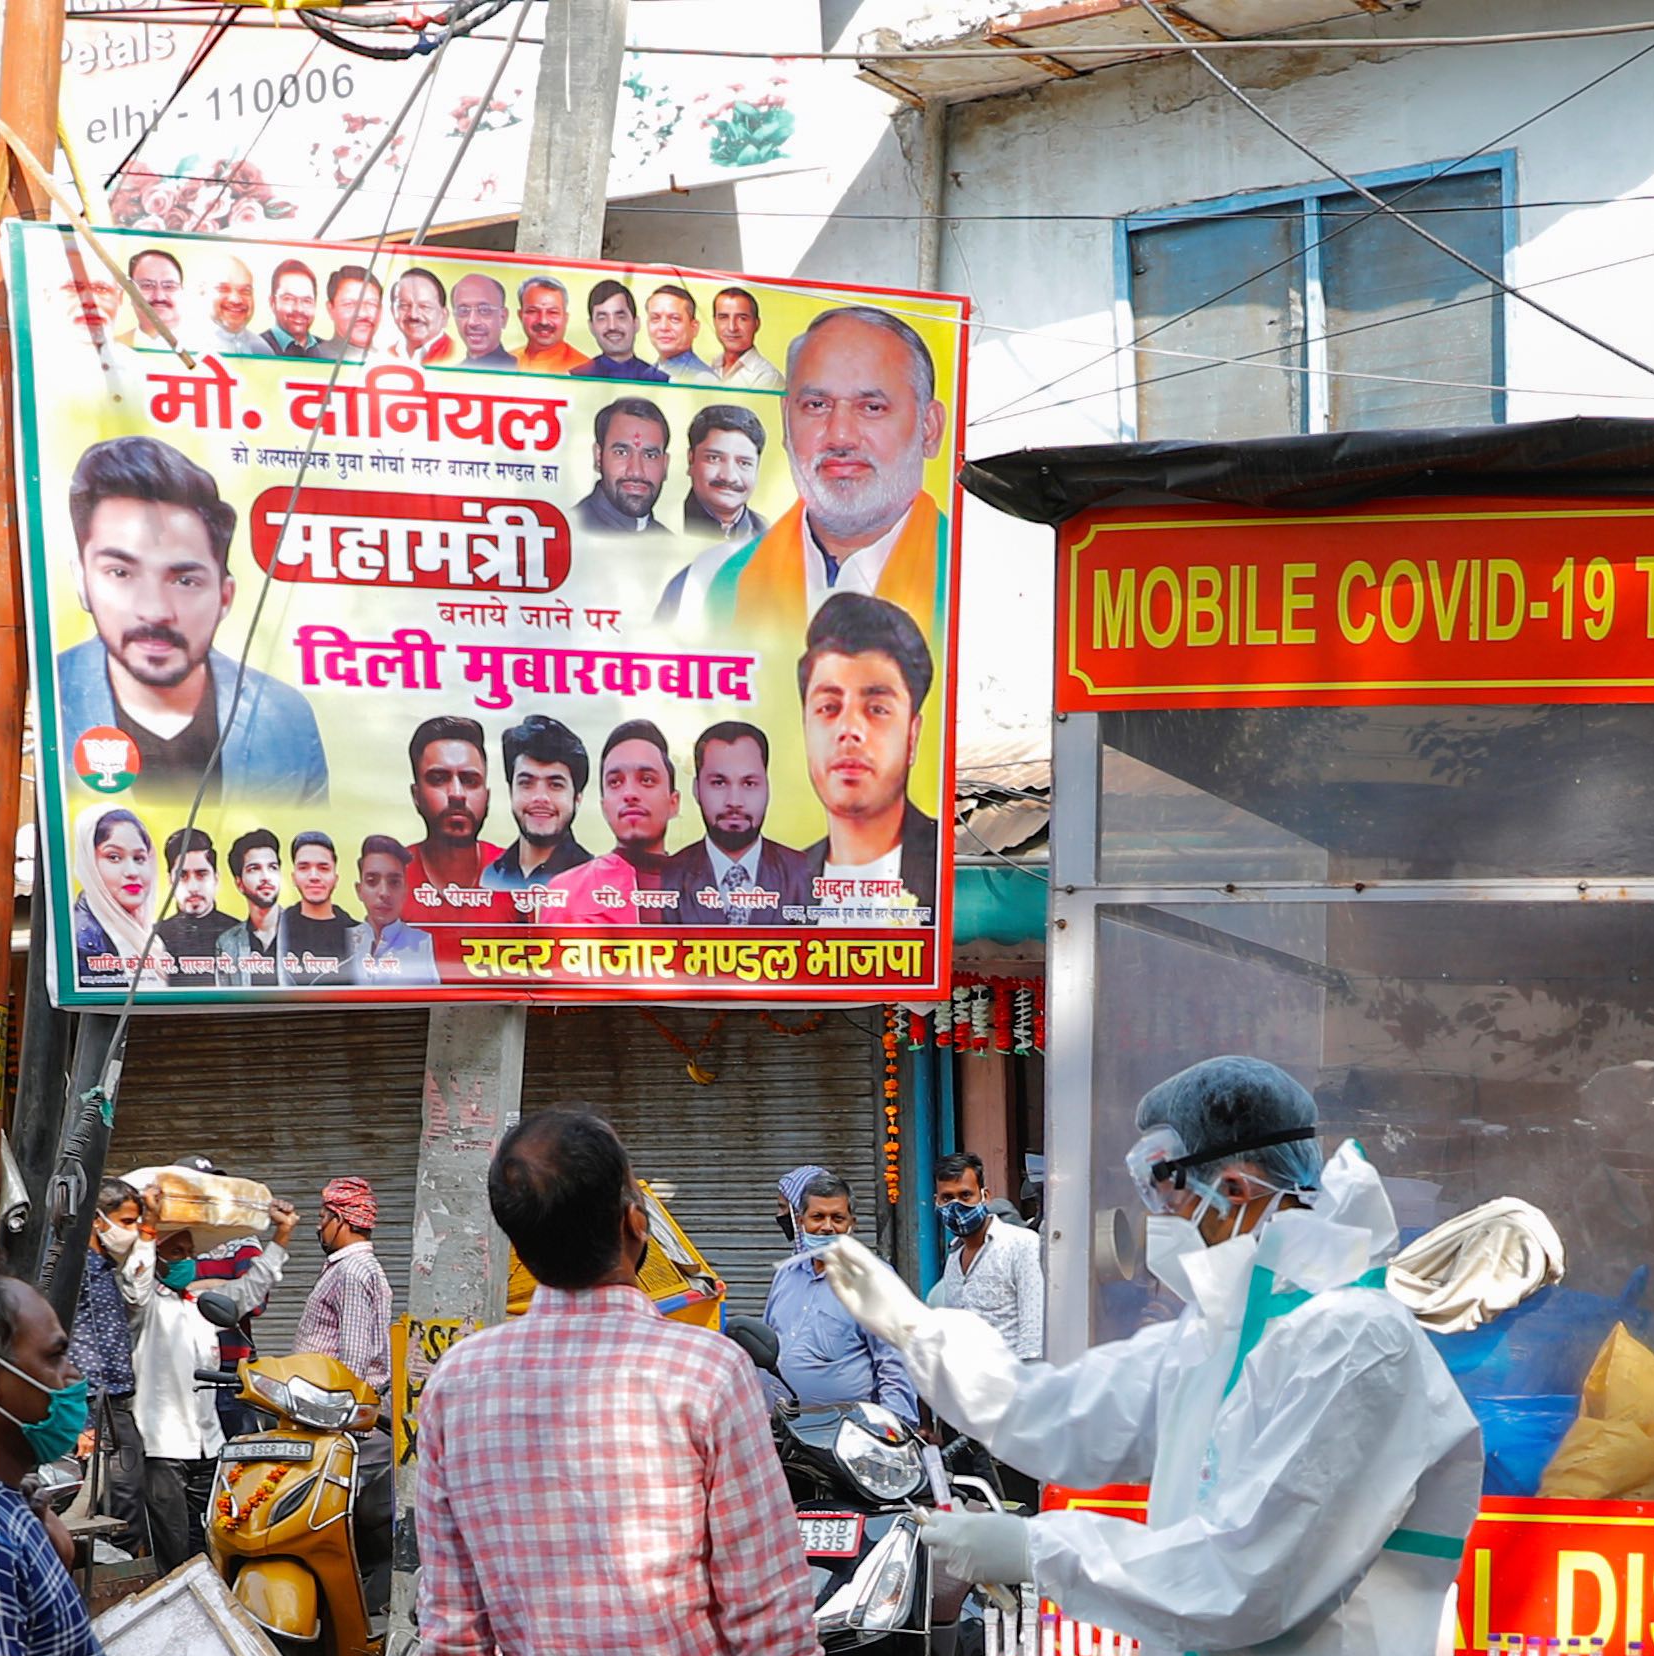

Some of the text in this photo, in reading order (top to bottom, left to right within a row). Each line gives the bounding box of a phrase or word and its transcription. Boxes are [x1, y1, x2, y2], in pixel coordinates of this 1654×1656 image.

[86, 63, 356, 144] elhi 110006
[148, 353, 568, 453] मो. दानियल
[337, 453, 364, 480] युवा
[412, 456, 441, 478] सदर
[541, 465, 560, 484] का
[265, 501, 556, 590] महामंत्री
[437, 599, 622, 634] बनाये जाने पर
[1091, 562, 1316, 650] MOBILE
[1336, 555, 1615, 643] COVID-19
[456, 643, 755, 710] मुबारकबाद
[460, 938, 925, 983] सदर बाजार मण्डल भाजपा
